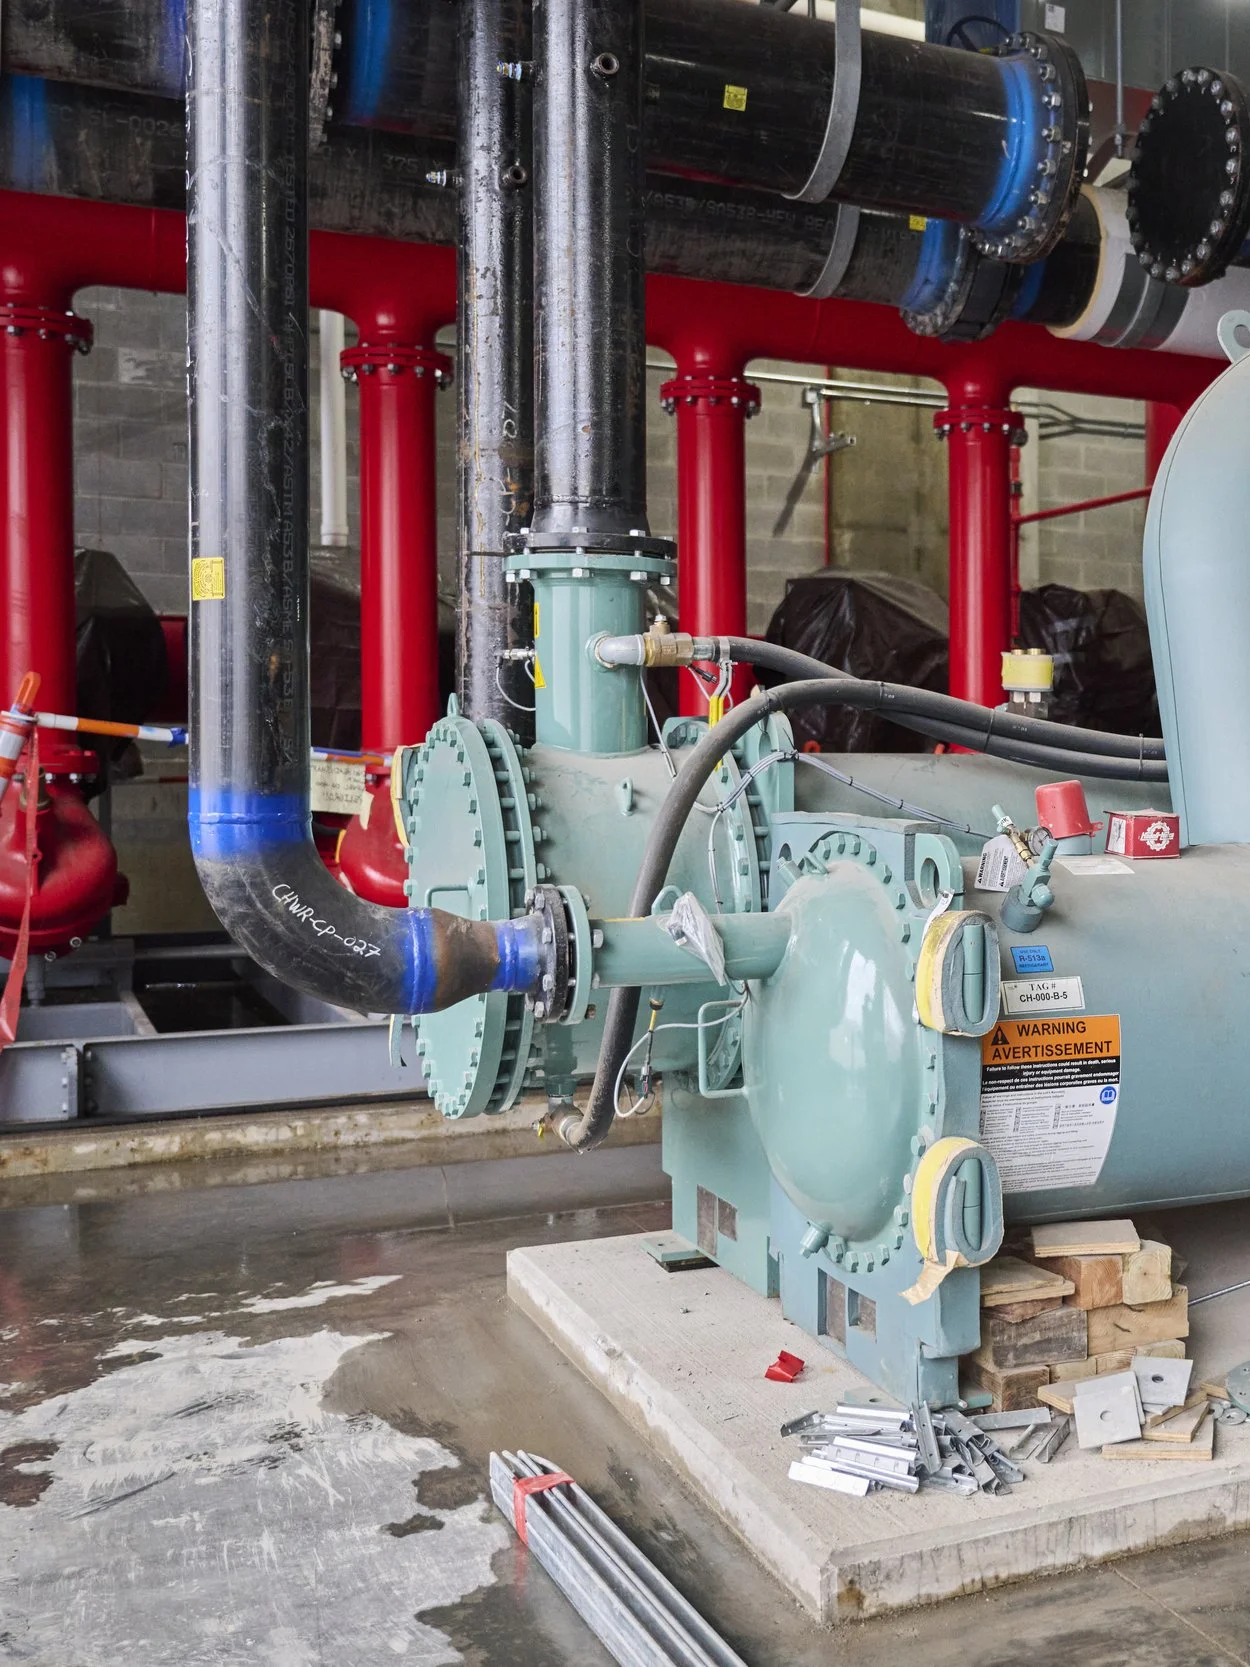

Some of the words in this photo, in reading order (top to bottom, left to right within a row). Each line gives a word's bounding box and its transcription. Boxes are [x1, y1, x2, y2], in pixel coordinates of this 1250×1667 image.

[979, 852, 988, 877] WARNING
[1029, 982, 1049, 991] TAG
[1019, 991, 1068, 1003] CH-000-B-5
[1016, 1021, 1086, 1037] WARNING
[992, 1041, 1112, 1061] AVERTISSEMENT
